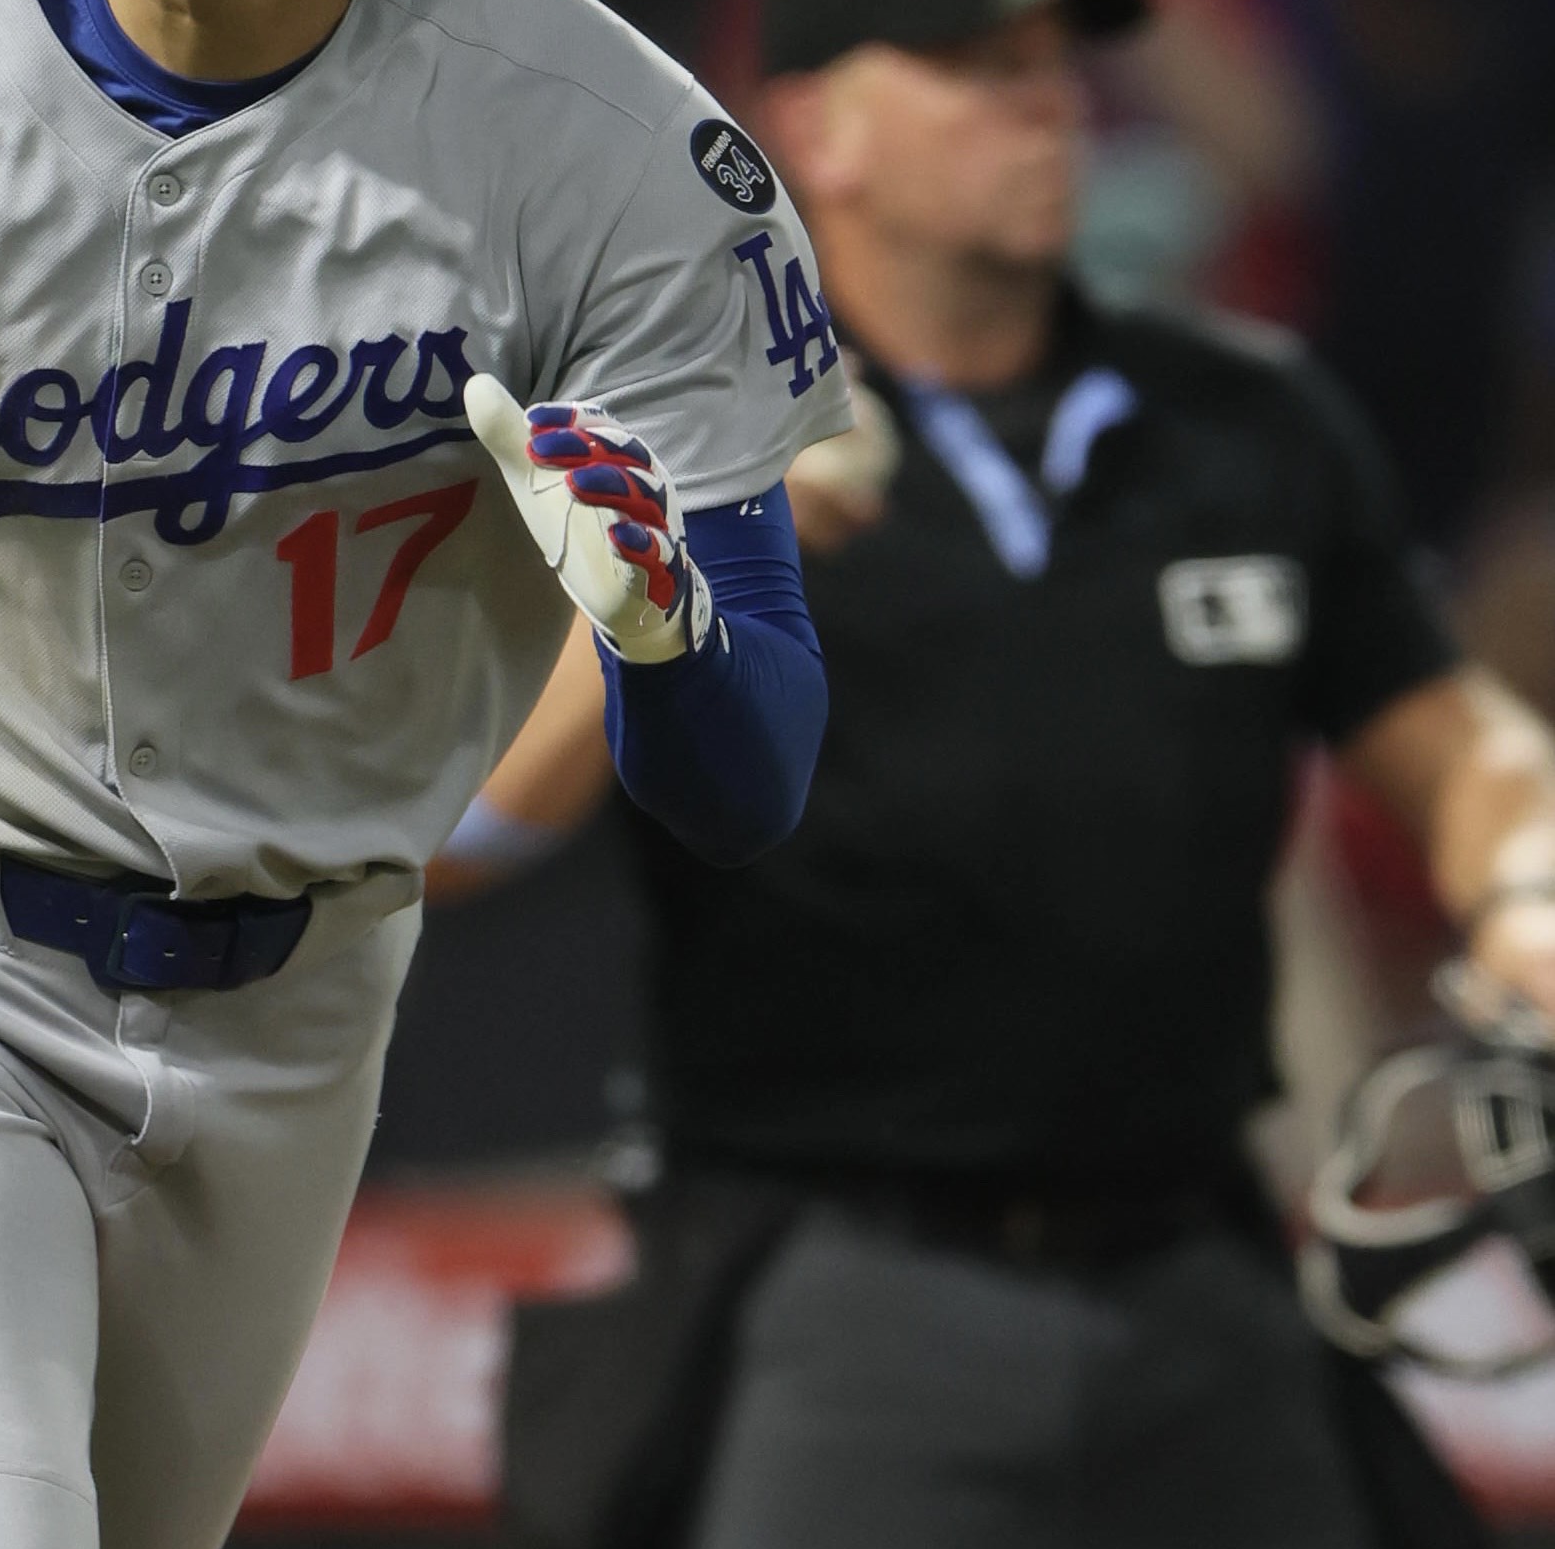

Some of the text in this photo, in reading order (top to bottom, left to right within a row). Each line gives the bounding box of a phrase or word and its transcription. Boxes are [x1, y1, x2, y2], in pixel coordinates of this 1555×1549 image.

[701, 130, 732, 172] FERNANDO
[716, 145, 765, 202] 34
[732, 231, 839, 399] LA
[276, 478, 479, 681] 17
